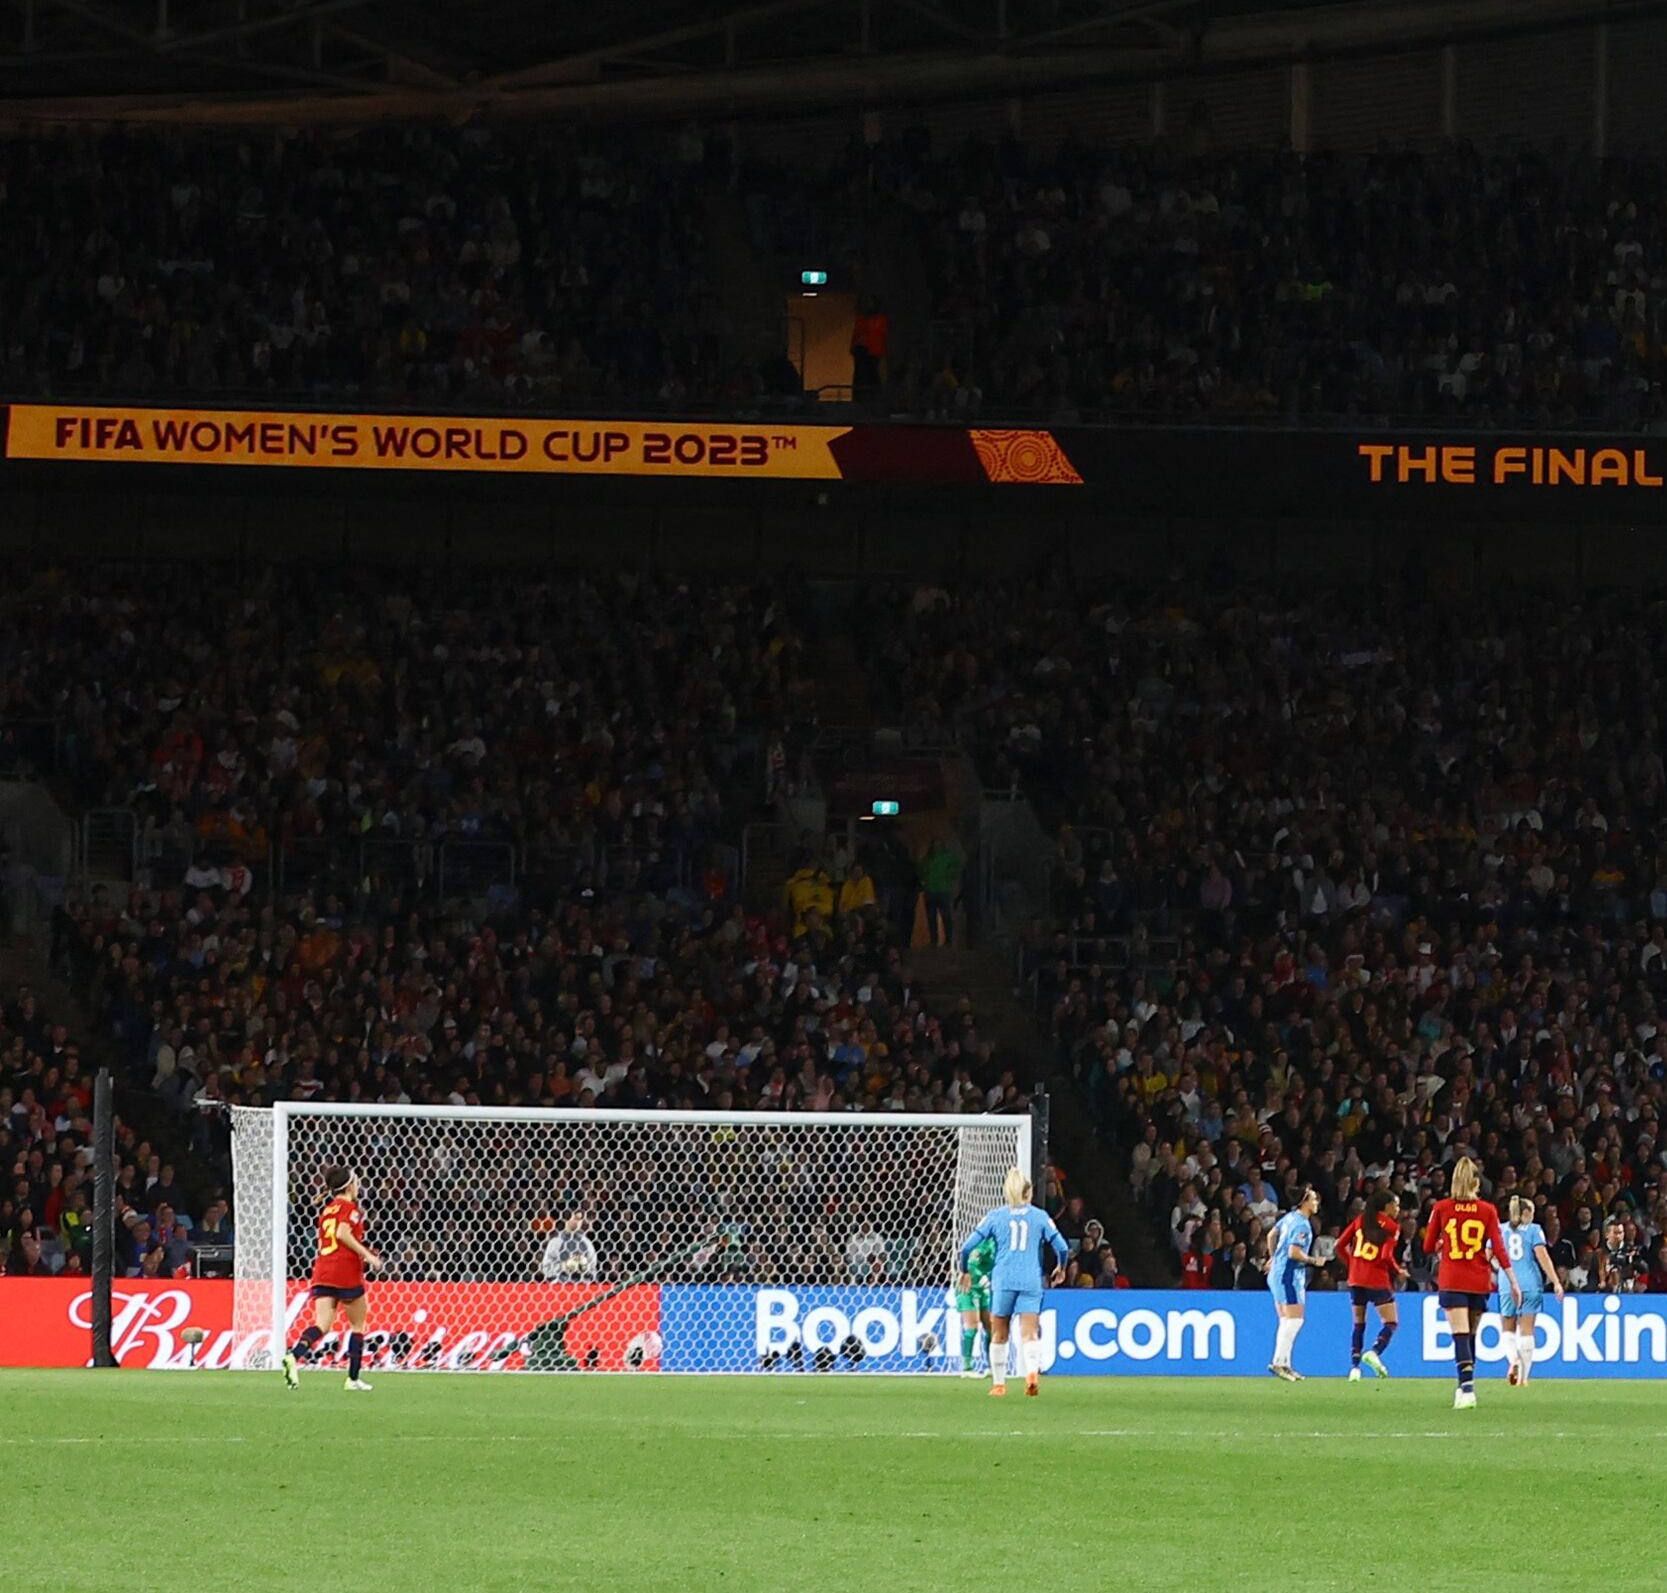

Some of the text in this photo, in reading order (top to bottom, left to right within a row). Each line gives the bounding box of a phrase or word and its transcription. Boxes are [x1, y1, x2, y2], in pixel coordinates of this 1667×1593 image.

[56, 417, 143, 450] FIFA
[152, 420, 360, 457] WOMEN'S
[373, 425, 528, 460] WORLD
[543, 431, 631, 463] CUP
[1359, 445, 1664, 487] THE FINAL
[321, 1218, 338, 1256] 3
[1009, 1220, 1029, 1252] 11
[1445, 1218, 1485, 1260] 19
[1508, 1233, 1523, 1260] 8
